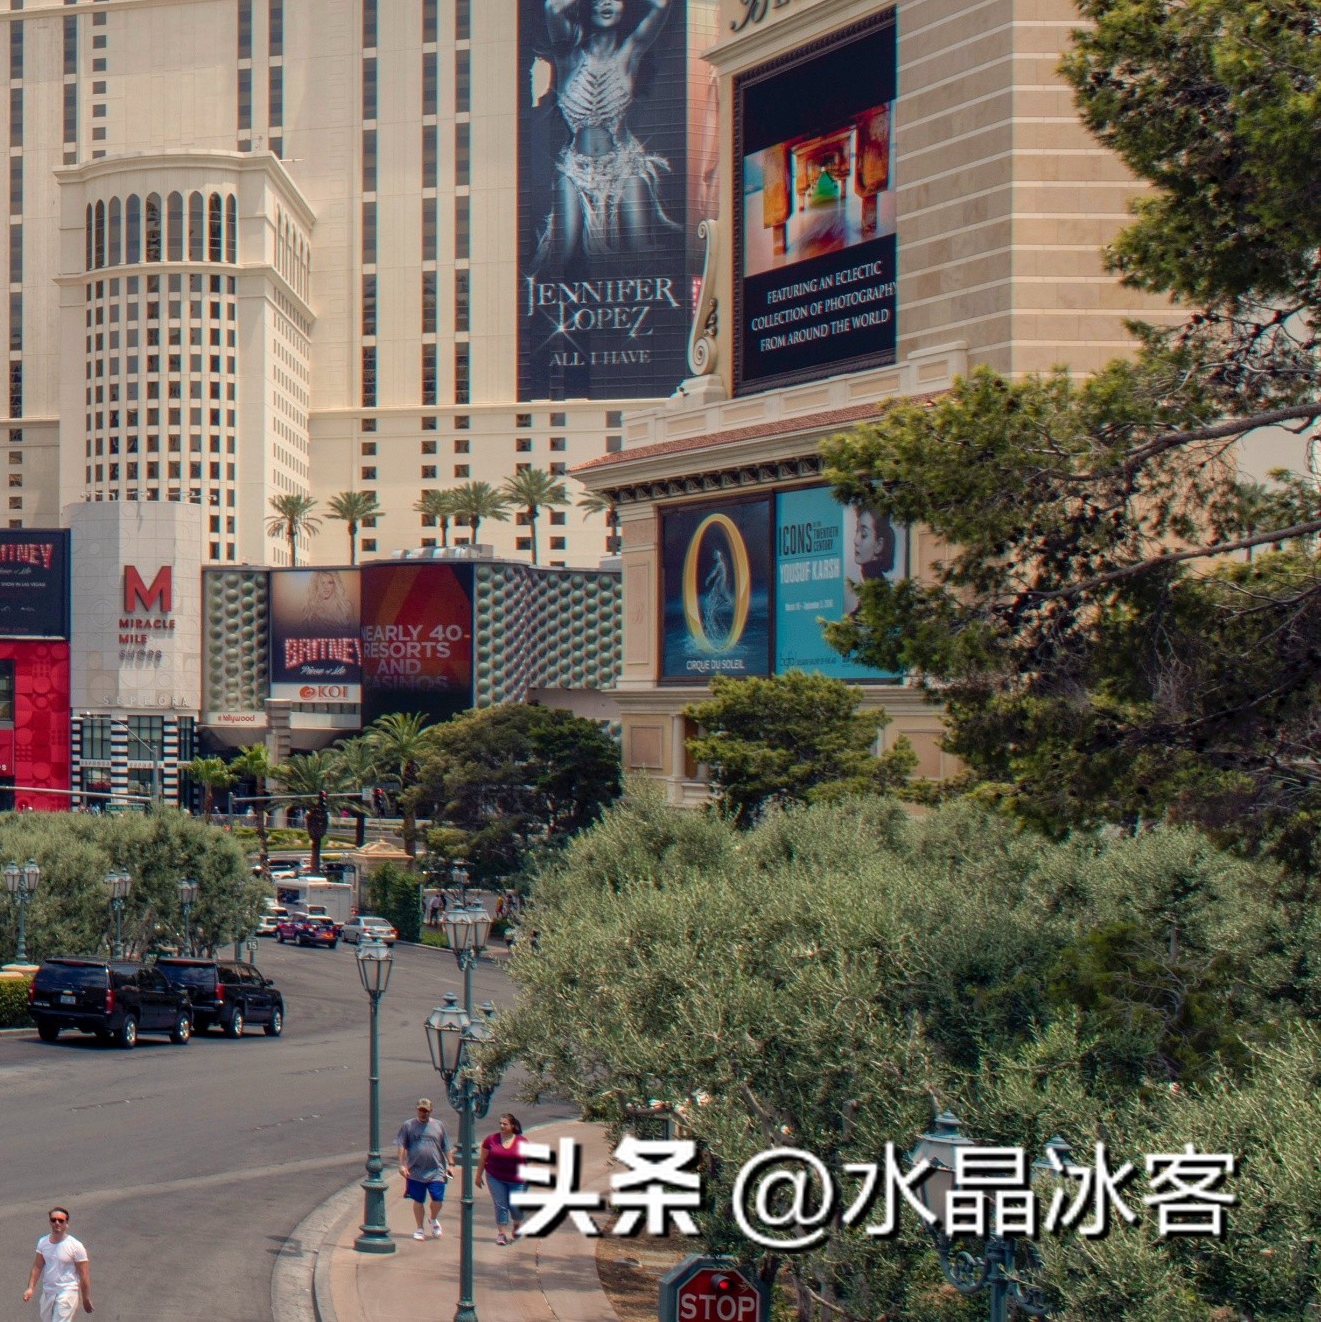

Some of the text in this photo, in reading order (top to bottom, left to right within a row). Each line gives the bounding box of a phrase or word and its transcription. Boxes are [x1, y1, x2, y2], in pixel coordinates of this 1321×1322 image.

[767, 260, 882, 304] FEATURING AN ECLECTIC
[526, 277, 681, 316] JENNIFER
[751, 281, 897, 331] COLLECTION OF PHOTOGRAPHY
[556, 300, 654, 337] LOPEZ
[760, 309, 890, 352] FROM AROUND THE WORLD
[549, 350, 651, 366] ALL I HAVE
[779, 523, 812, 556] ICONS
[124, 565, 172, 613] M
[119, 619, 175, 630] MIRACLE
[361, 624, 424, 641] NEARLY
[119, 634, 148, 644] MILE
[119, 650, 162, 661] SHOPS
[363, 641, 451, 658] RESORTS
[377, 658, 422, 674] AND
[686, 659, 745, 672] CIRQUE DU SOLEIL
[364, 675, 449, 690] ASINOS
[318, 686, 348, 697] KOI
[103, 696, 191, 707] SEPHORA
[247, 942, 257, 951] 15
[681, 1293, 755, 1322] STOP
